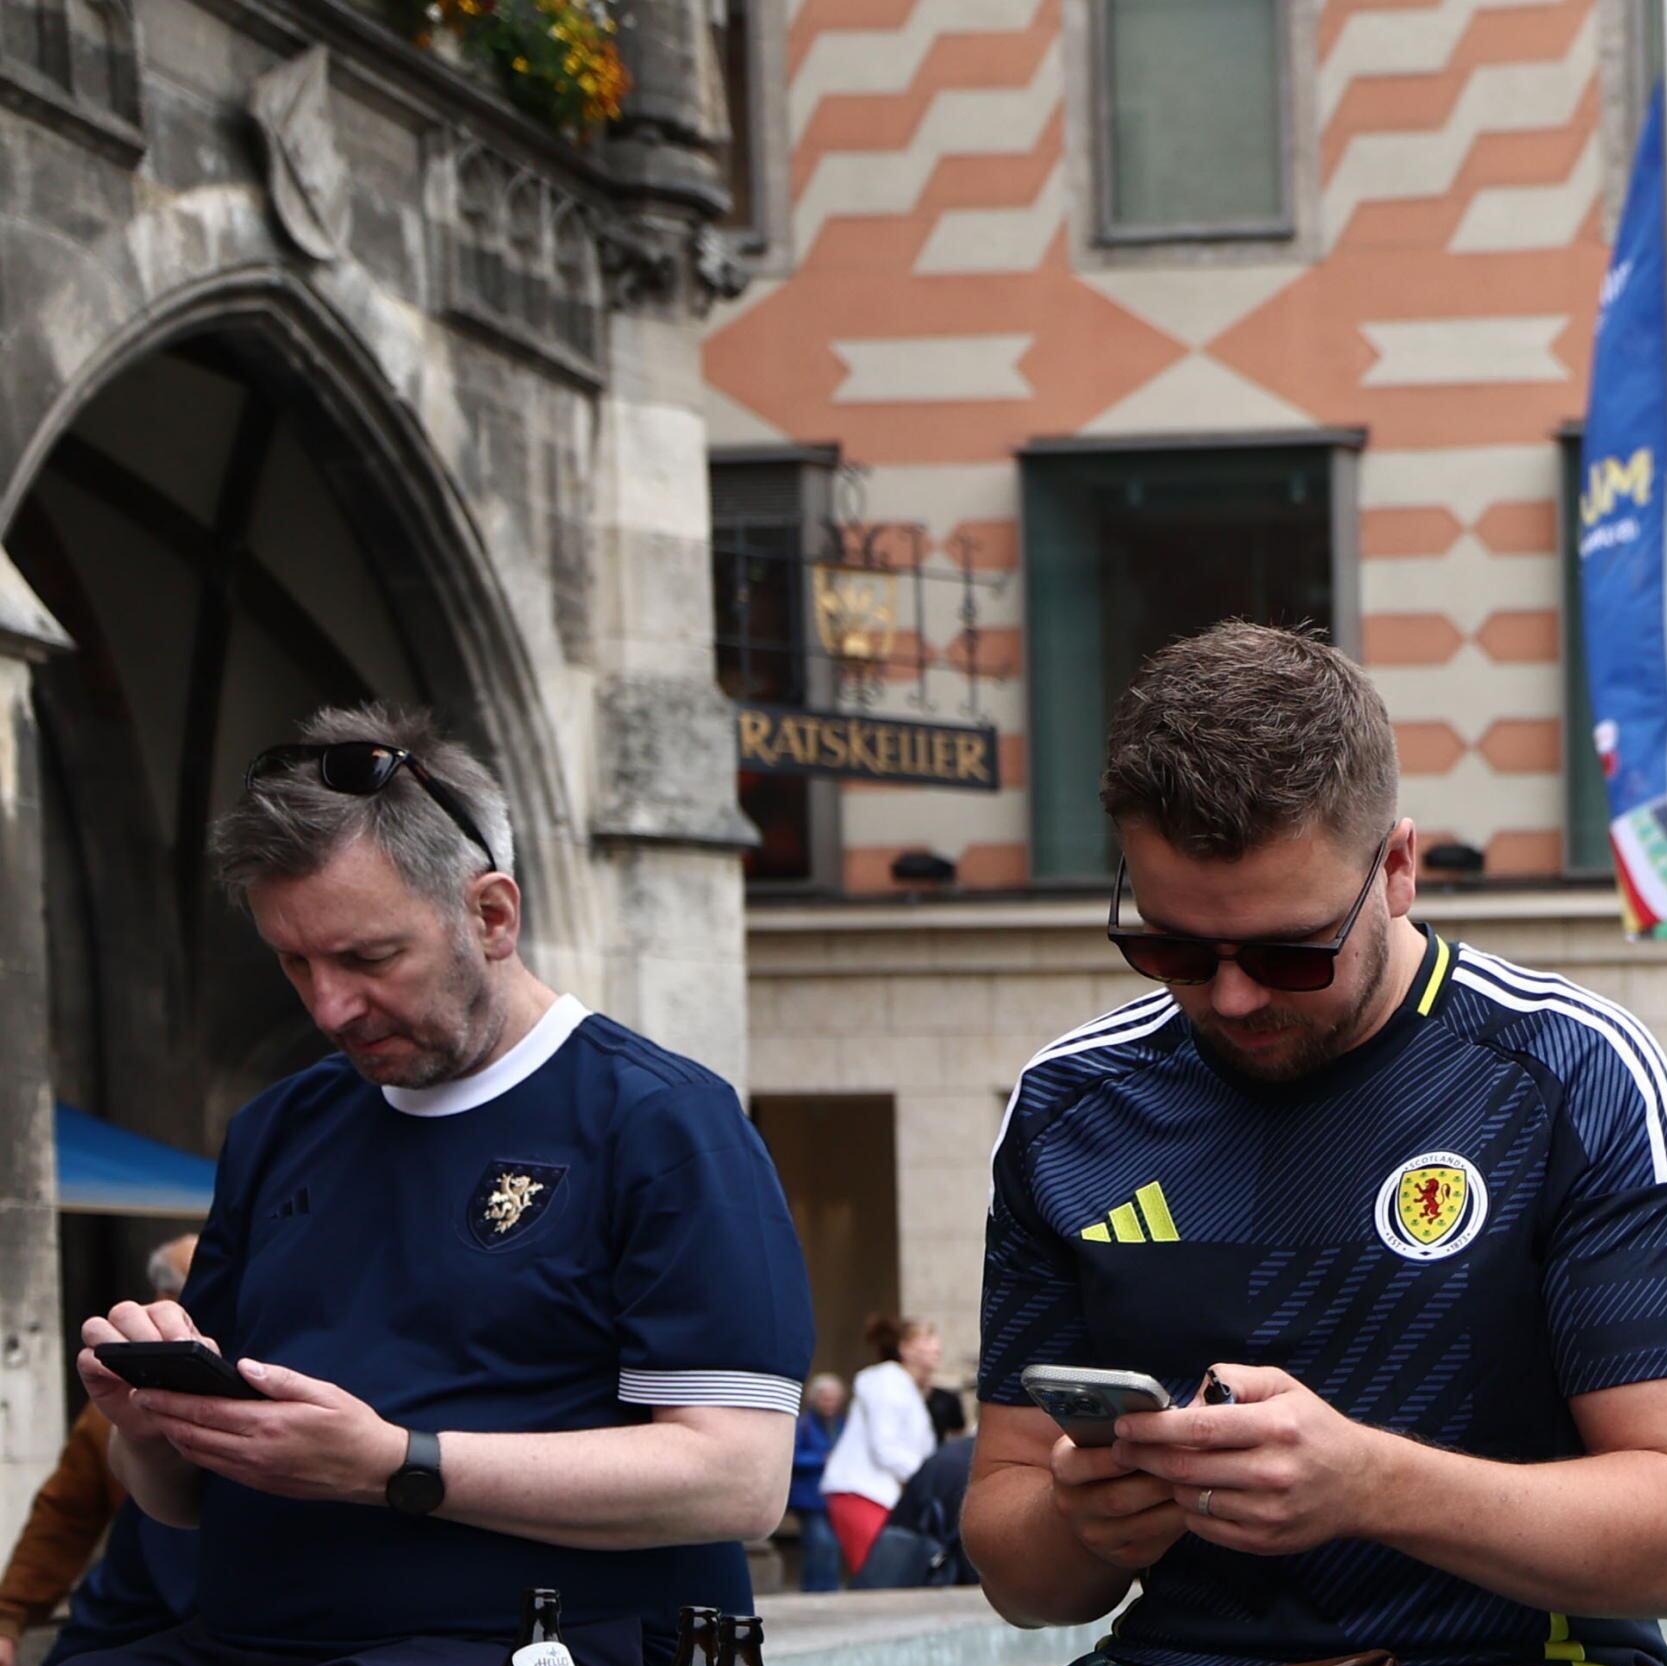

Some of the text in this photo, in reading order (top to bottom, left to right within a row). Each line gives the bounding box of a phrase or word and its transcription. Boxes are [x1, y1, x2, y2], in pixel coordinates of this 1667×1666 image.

[739, 710, 990, 782] RATSKELLER
[1409, 1155, 1461, 1169] SCOTLAND
[1387, 1234, 1402, 1248] EST
